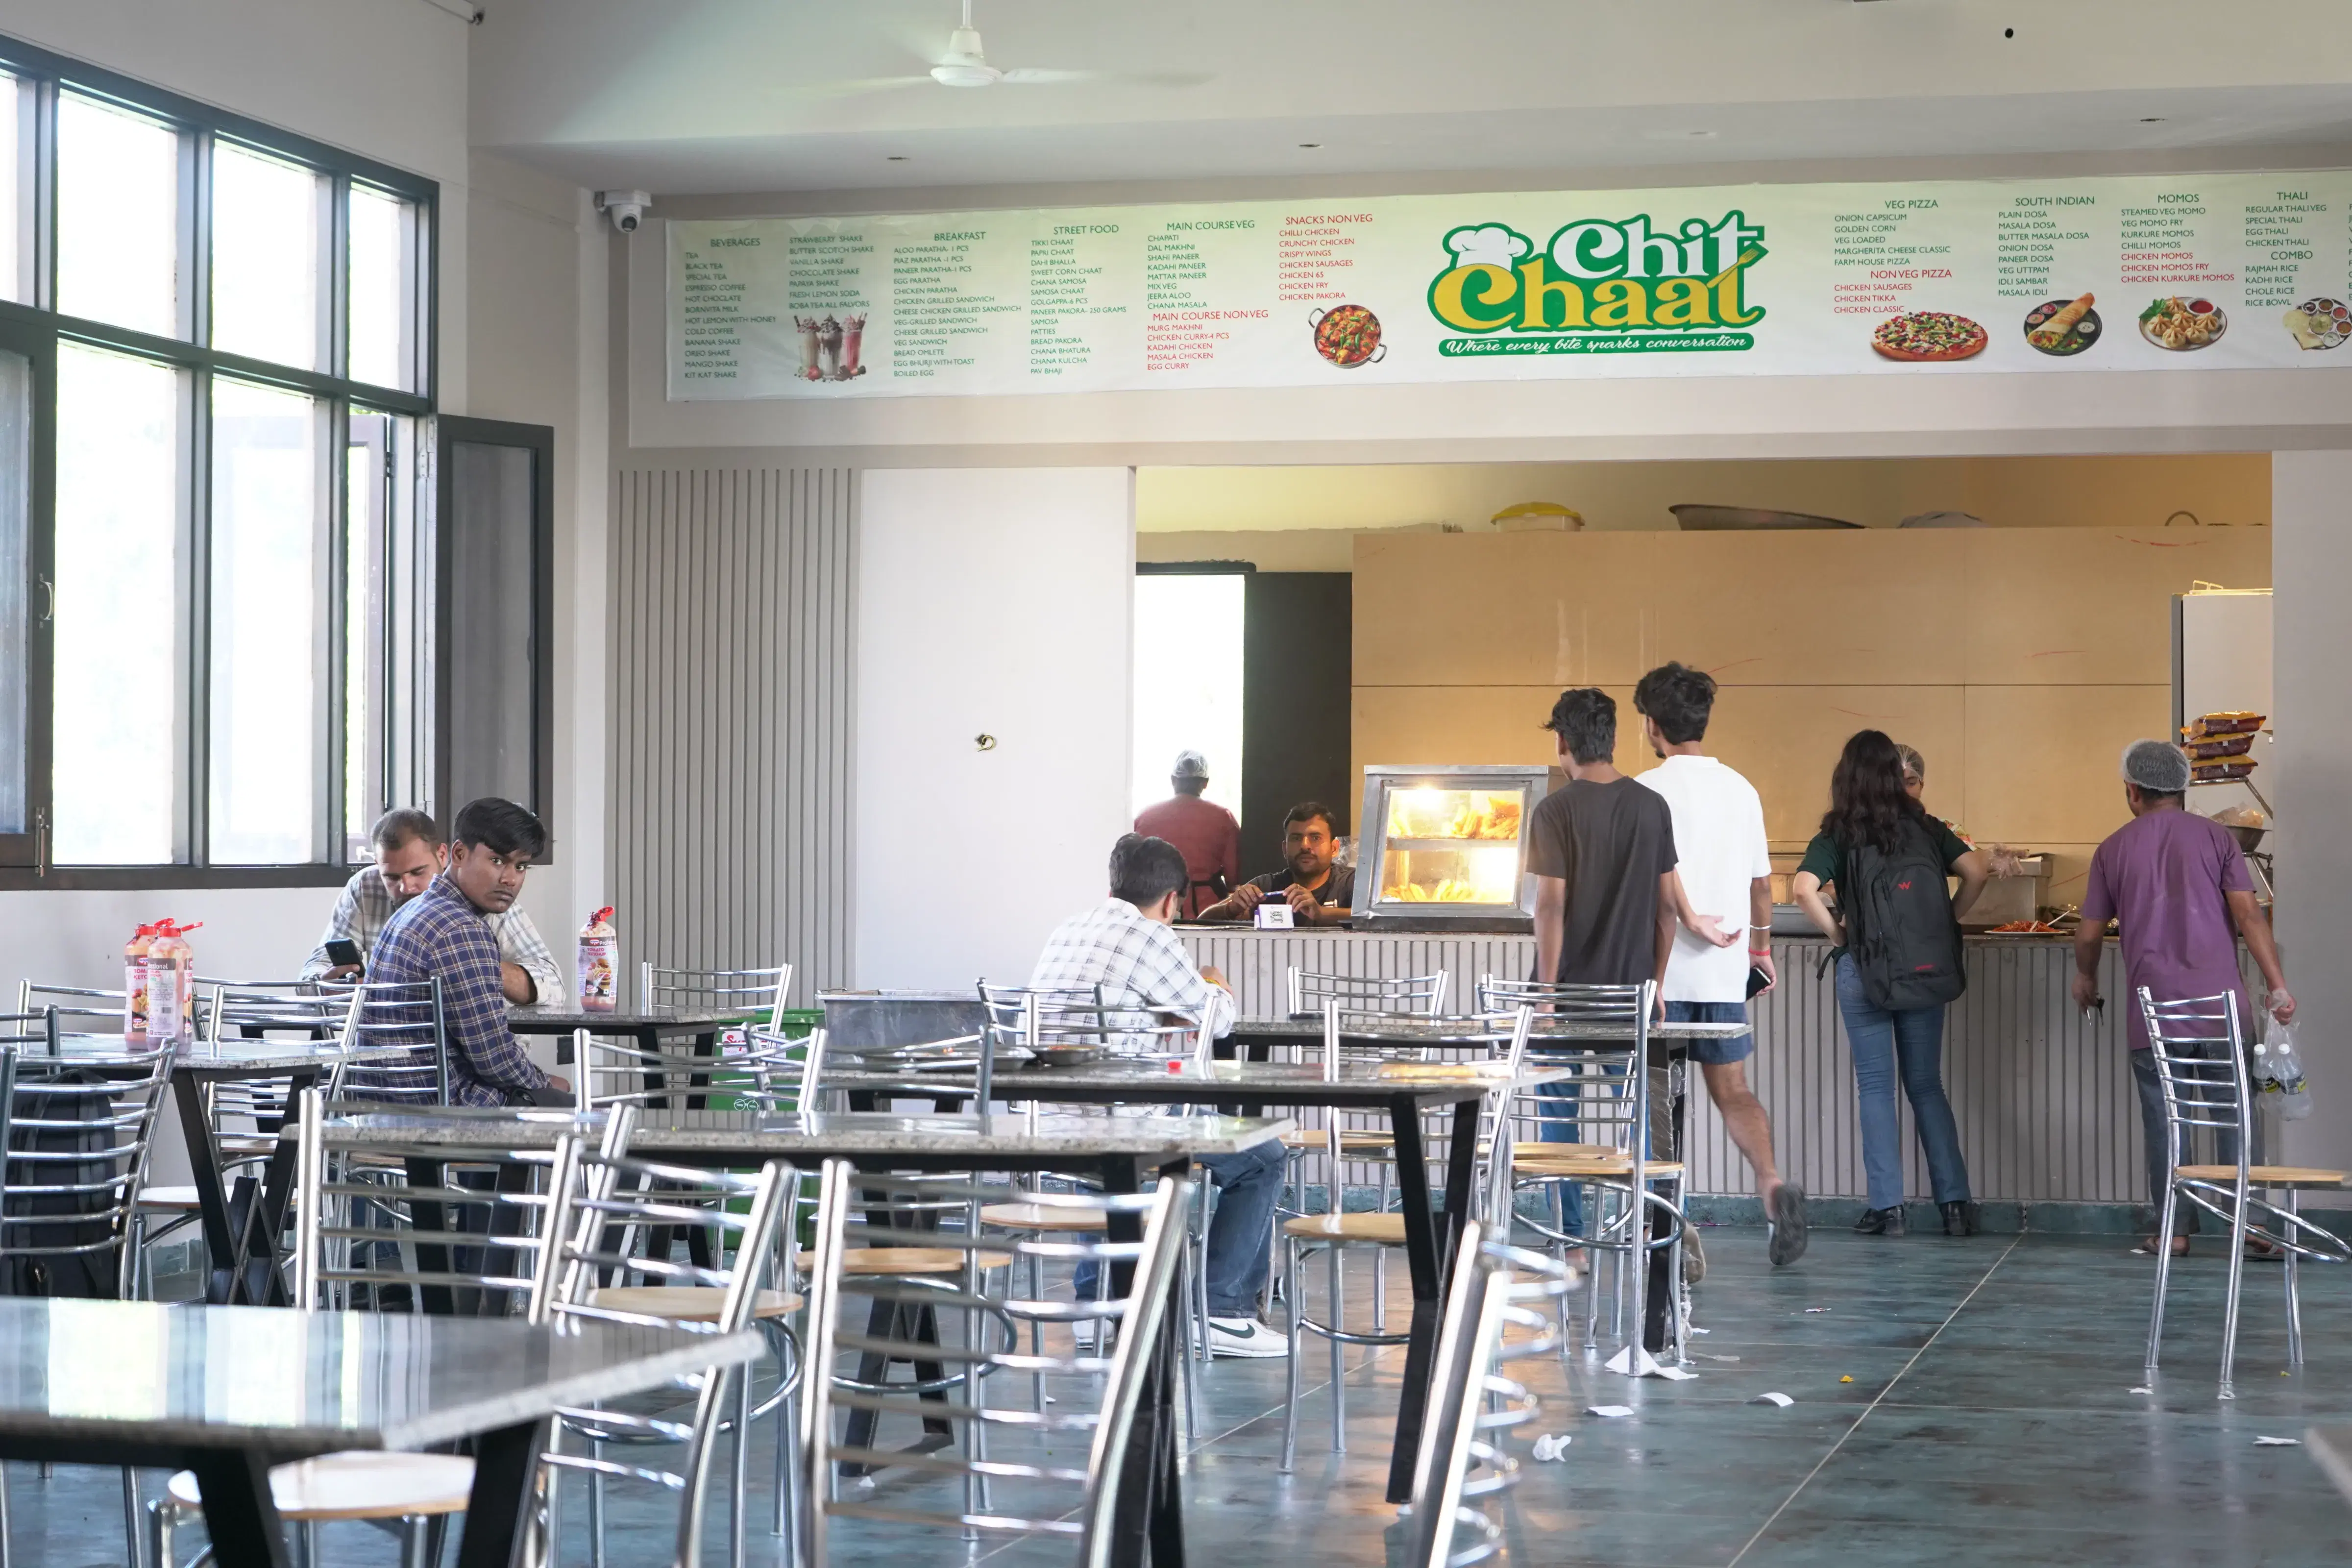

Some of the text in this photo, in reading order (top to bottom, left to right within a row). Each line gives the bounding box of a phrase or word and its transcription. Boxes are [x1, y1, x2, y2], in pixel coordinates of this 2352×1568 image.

[2016, 196, 2094, 206] SOUTH INDIAN
[2158, 194, 2199, 203] MOMOS
[2277, 192, 2307, 200] THALI
[1885, 200, 1938, 209] VEG PIZZA
[1286, 214, 1372, 225] SNACKS NON VEG
[1054, 224, 1119, 235] STREET FOOD
[1167, 220, 1254, 231] MAIN COURSE VEG
[934, 232, 986, 241] BREAKFAST
[710, 238, 760, 247] BEVERAGES
[1553, 214, 1758, 279] Chit
[2271, 250, 2313, 260] COMBO
[1871, 269, 1952, 279] NON VEG PIZZA
[2246, 265, 2278, 274] RAJMAH
[1434, 257, 1760, 329] Chaat
[1153, 310, 1268, 321] MAIN COURSE NON VEG
[1446, 335, 1746, 354] Where every bite sparks conversation
